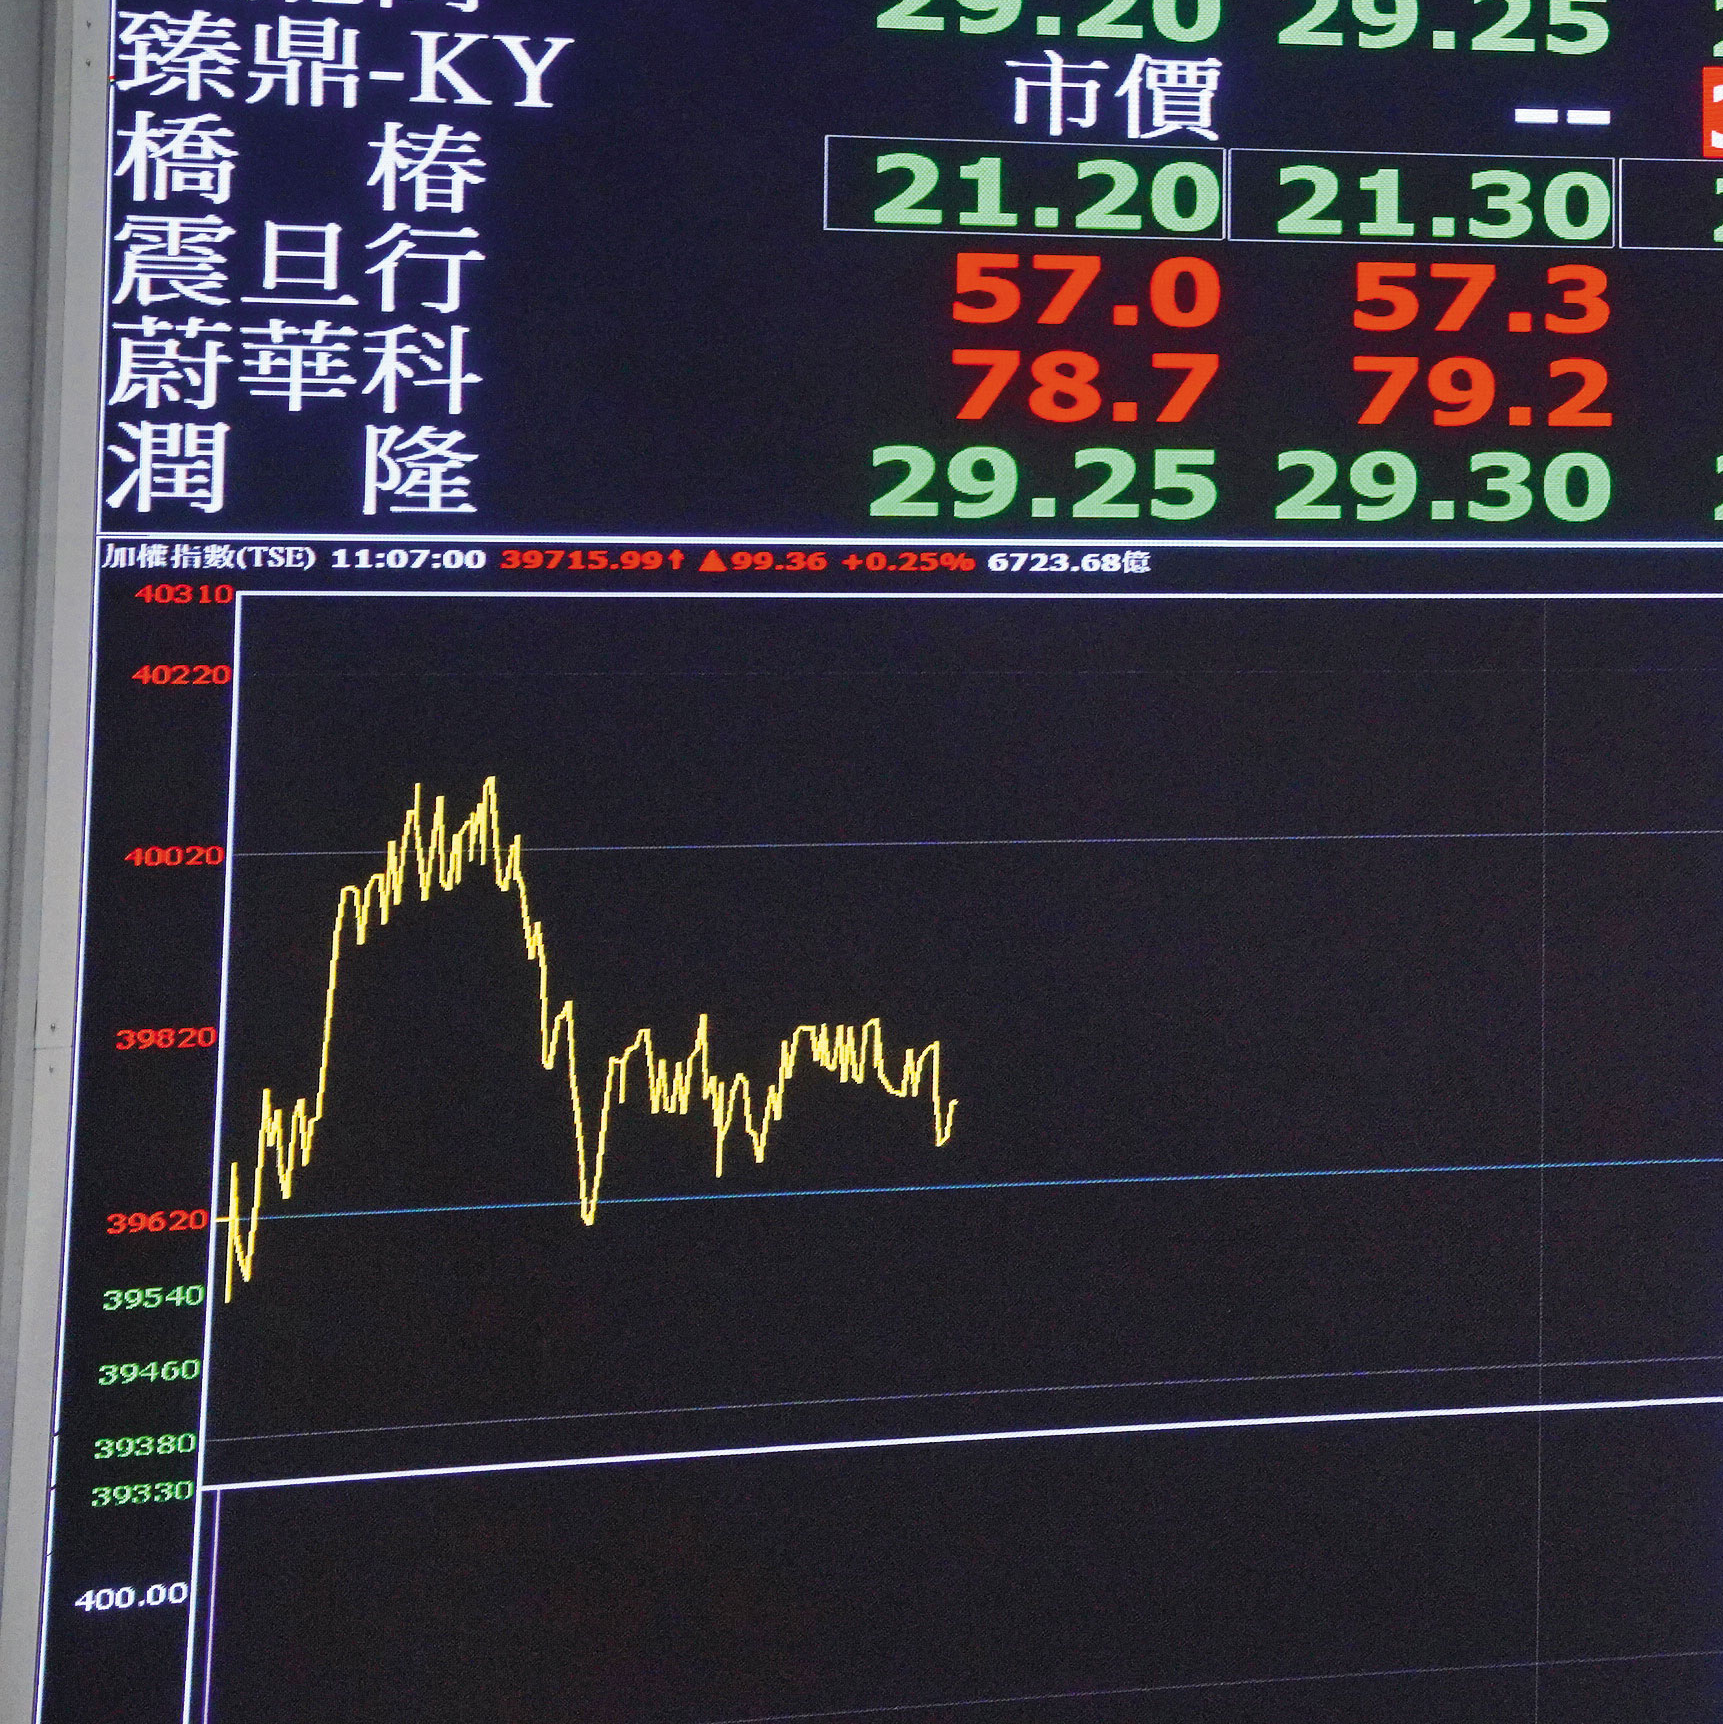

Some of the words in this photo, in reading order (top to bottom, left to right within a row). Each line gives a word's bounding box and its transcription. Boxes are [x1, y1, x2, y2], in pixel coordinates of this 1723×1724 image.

[115, 9, 575, 109] 臻鼎-KY
[1004, 49, 1223, 141] 市價
[873, 152, 1221, 232] 21.20
[1276, 164, 1611, 241] 21.30
[111, 214, 486, 314] 震旦行
[951, 252, 1222, 329] 57.0
[1352, 261, 1611, 335] 57.3
[108, 314, 484, 415] 蔚華科
[951, 348, 1220, 423] 78.7
[1352, 355, 1613, 428] 79.2
[869, 444, 1218, 521] 29.25
[1274, 449, 1612, 523] 29.30
[331, 548, 487, 569] 11:07:00
[499, 549, 664, 571] 39715.99
[730, 551, 829, 571] 99.36
[841, 551, 977, 572] +0.25%
[134, 583, 235, 604] 40310
[131, 664, 232, 685] 40220
[123, 845, 225, 867] 40020
[115, 1026, 218, 1051] 39820
[106, 1208, 209, 1235] 39620
[102, 1284, 206, 1311] 39540
[74, 1581, 189, 1612] 400.00
